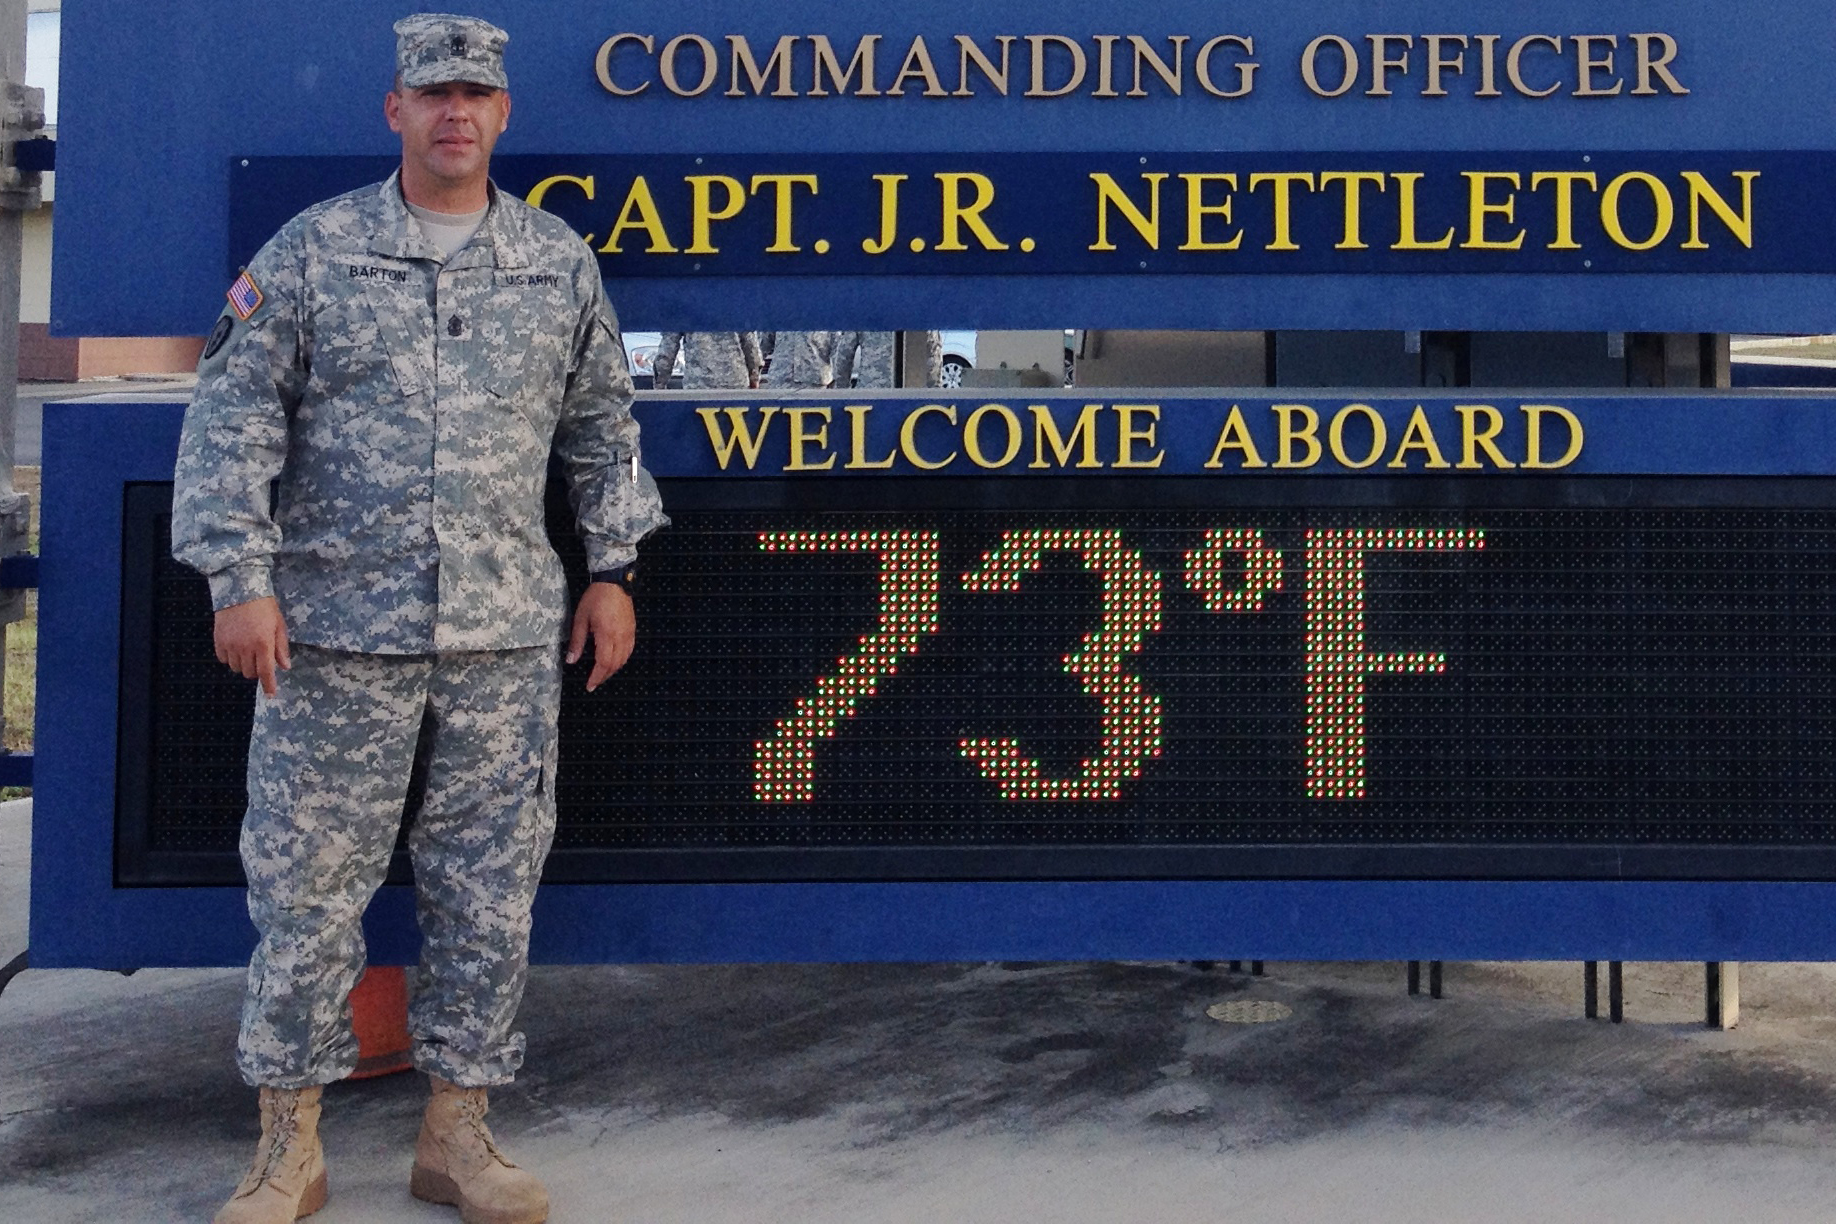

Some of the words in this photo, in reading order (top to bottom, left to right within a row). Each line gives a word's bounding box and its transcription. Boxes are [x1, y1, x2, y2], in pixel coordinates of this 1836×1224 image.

[594, 32, 1261, 100] COMMANDING
[1299, 31, 1693, 99] OFFICER
[861, 172, 1036, 254] J.R.
[1089, 170, 1761, 253] NETTLETON
[350, 265, 407, 282] BARTON
[527, 274, 559, 288] ARMY
[696, 404, 1165, 471] WELCOME
[1204, 404, 1585, 471] ABOARD
